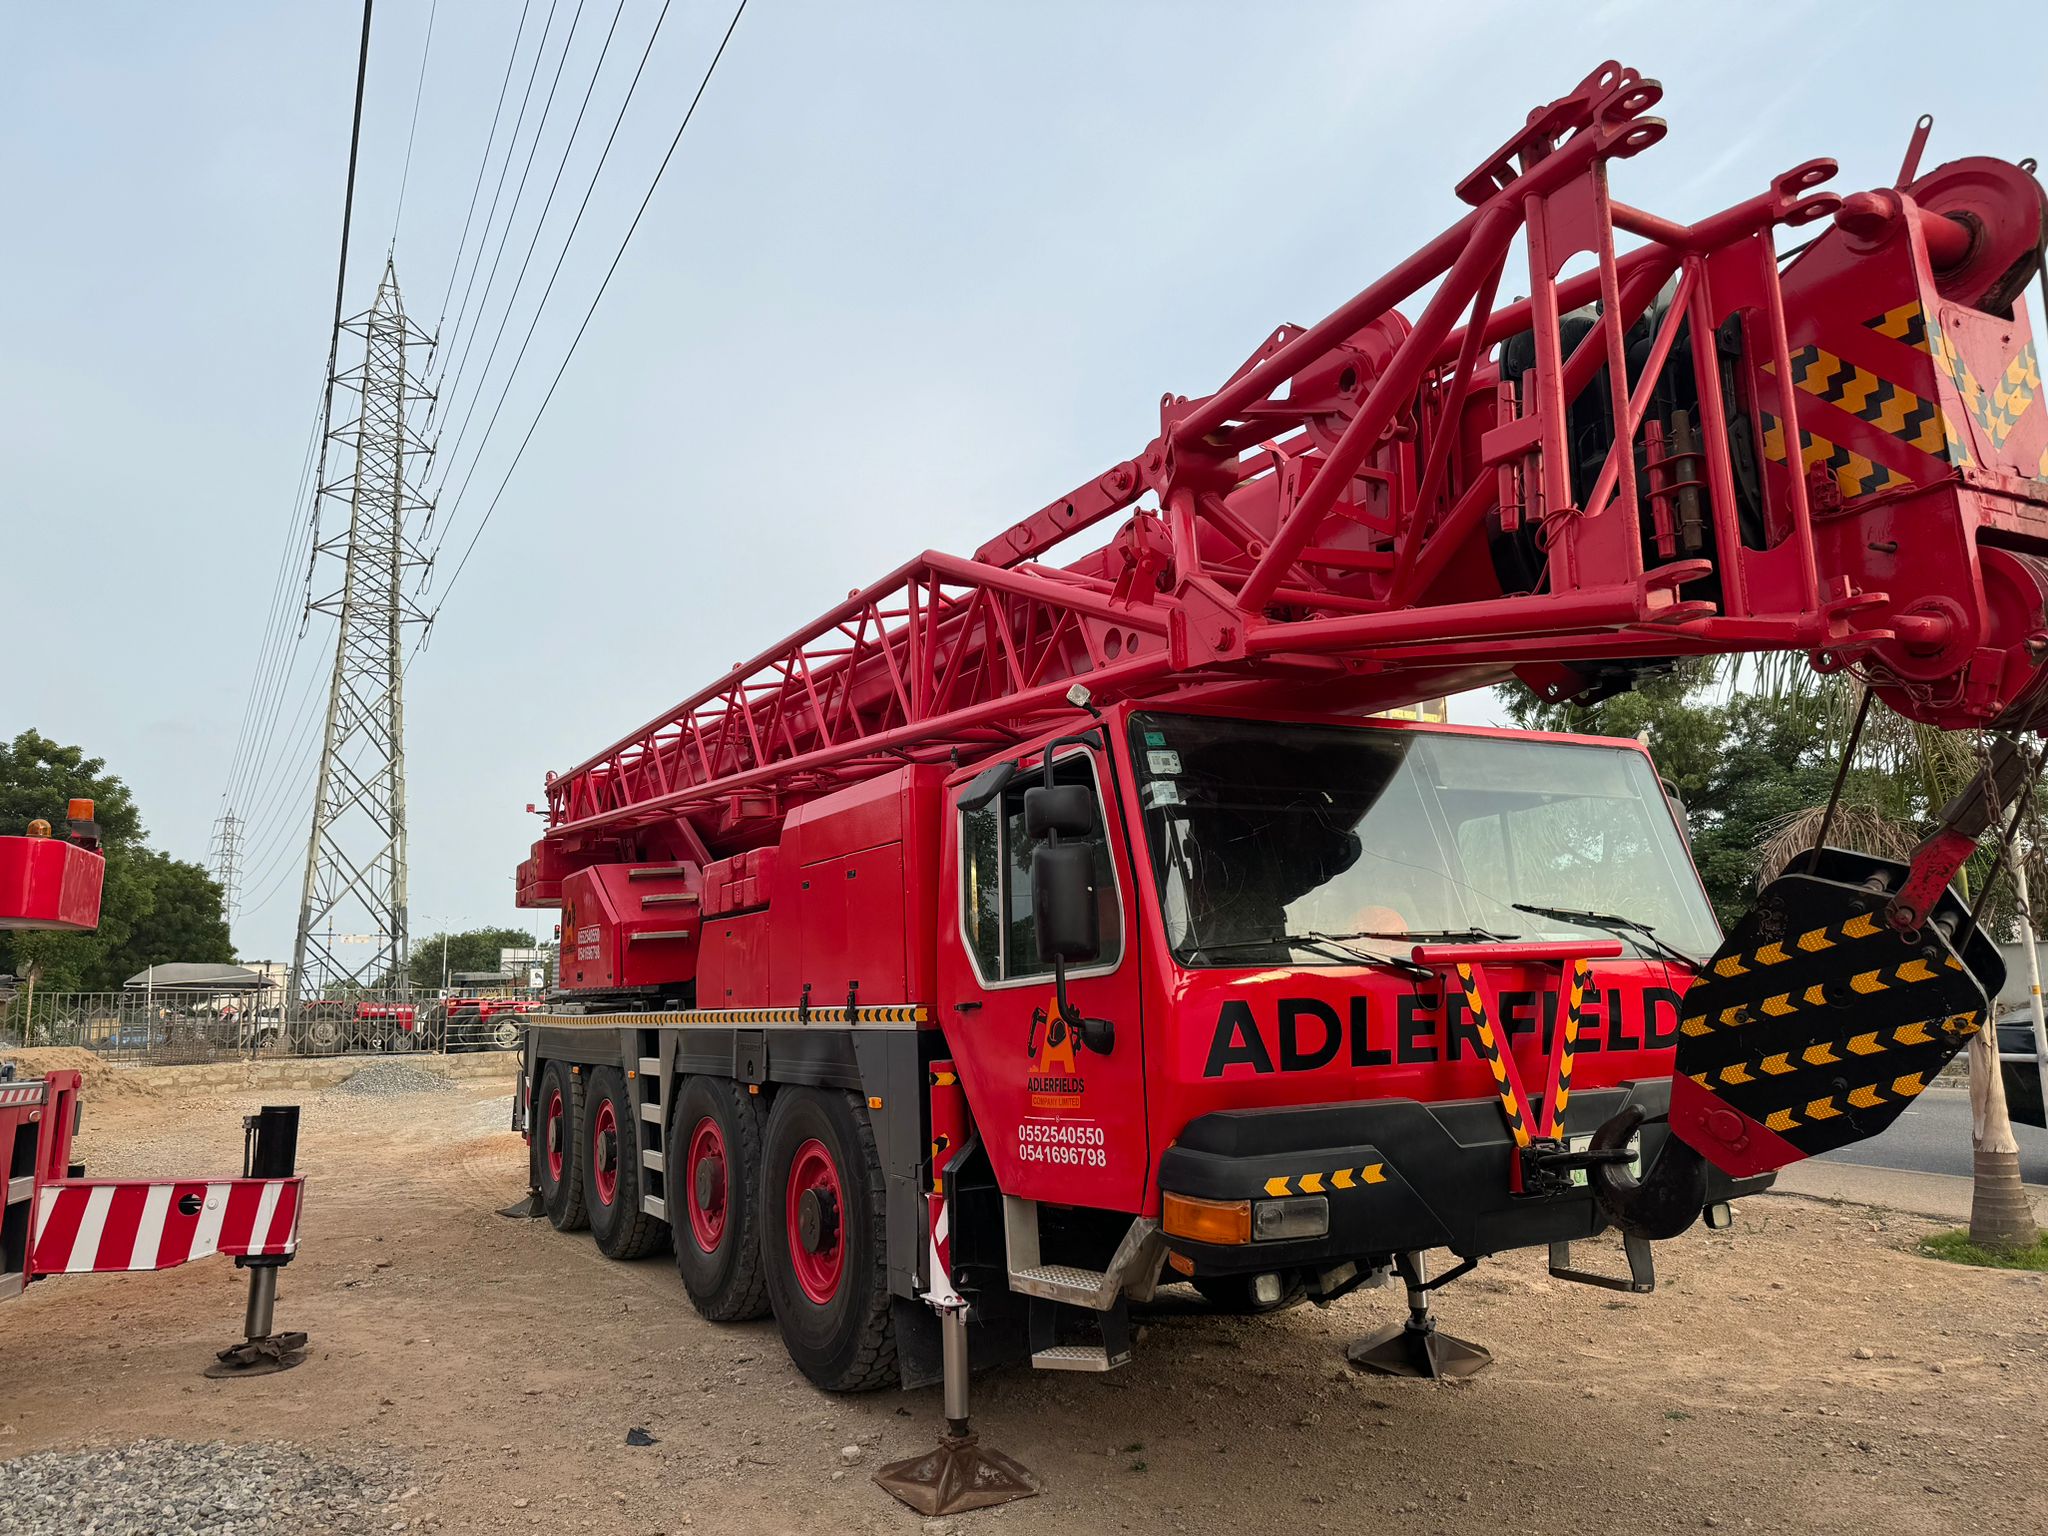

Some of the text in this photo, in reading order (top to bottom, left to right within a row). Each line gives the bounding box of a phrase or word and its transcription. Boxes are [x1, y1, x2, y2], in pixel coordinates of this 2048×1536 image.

[1027, 1077, 1085, 1094] ADLERFIELDS
[1032, 1096, 1080, 1106] COMPANY LIMITED
[1018, 1124, 1105, 1146] 0552540550
[1019, 1143, 1107, 1167] 0541696798
